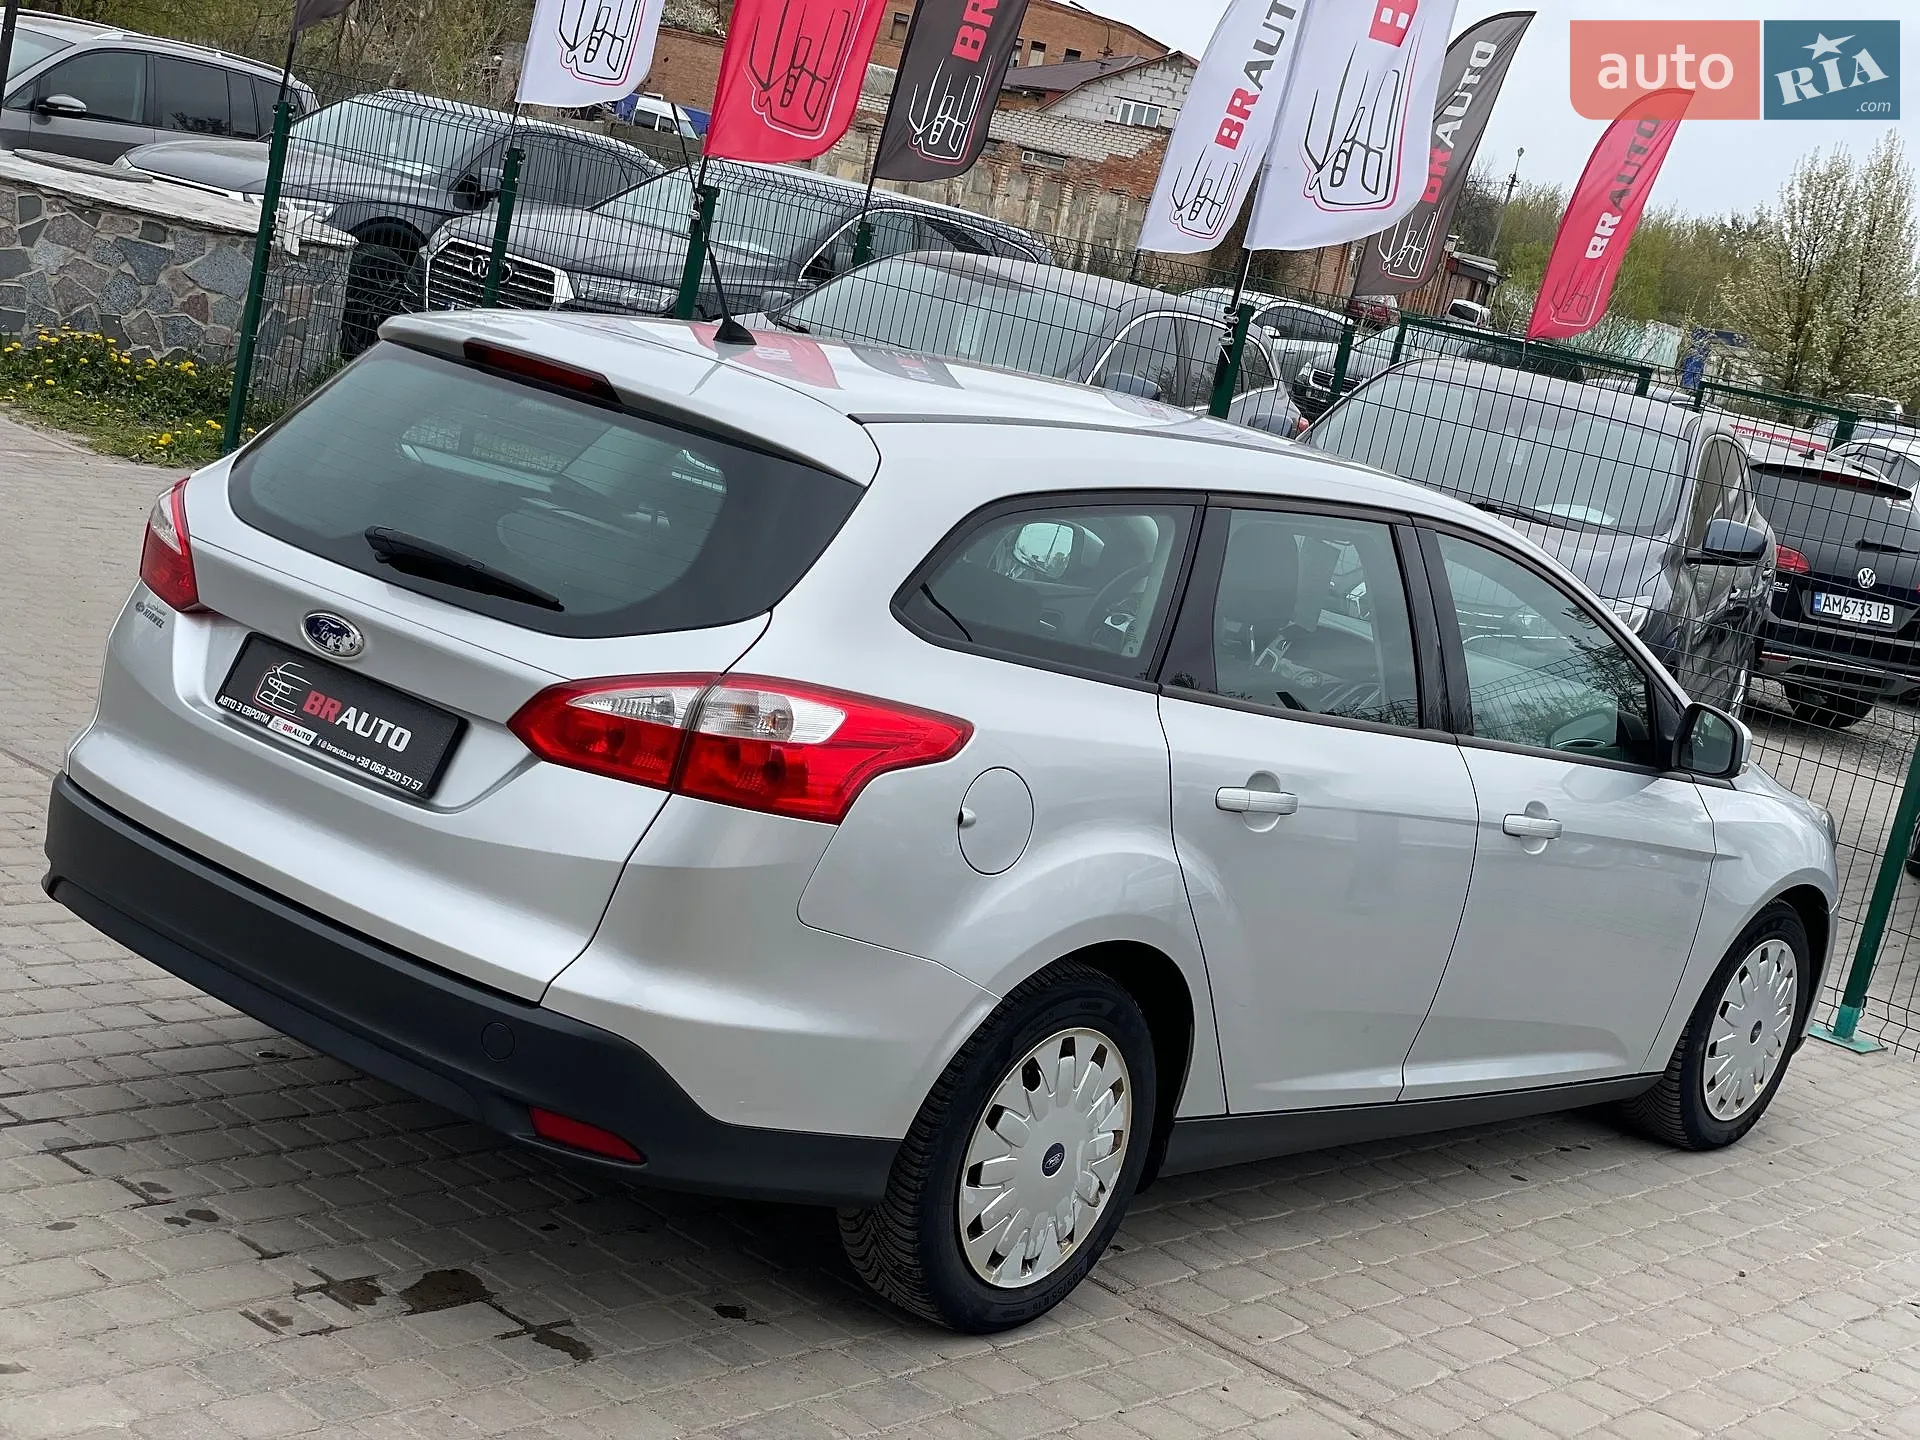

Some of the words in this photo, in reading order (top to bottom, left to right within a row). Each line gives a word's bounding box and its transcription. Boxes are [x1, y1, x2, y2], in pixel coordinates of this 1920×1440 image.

[1585, 114, 1662, 259] BRAUTO
[217, 694, 237, 710] АВТО
[282, 723, 312, 742] BRAUTO
[303, 690, 412, 753] BRAUTO
[356, 756, 371, 769] +38
[369, 761, 386, 776] 068
[385, 768, 401, 782] 320
[400, 774, 413, 787] 57
[410, 779, 424, 791] 57
